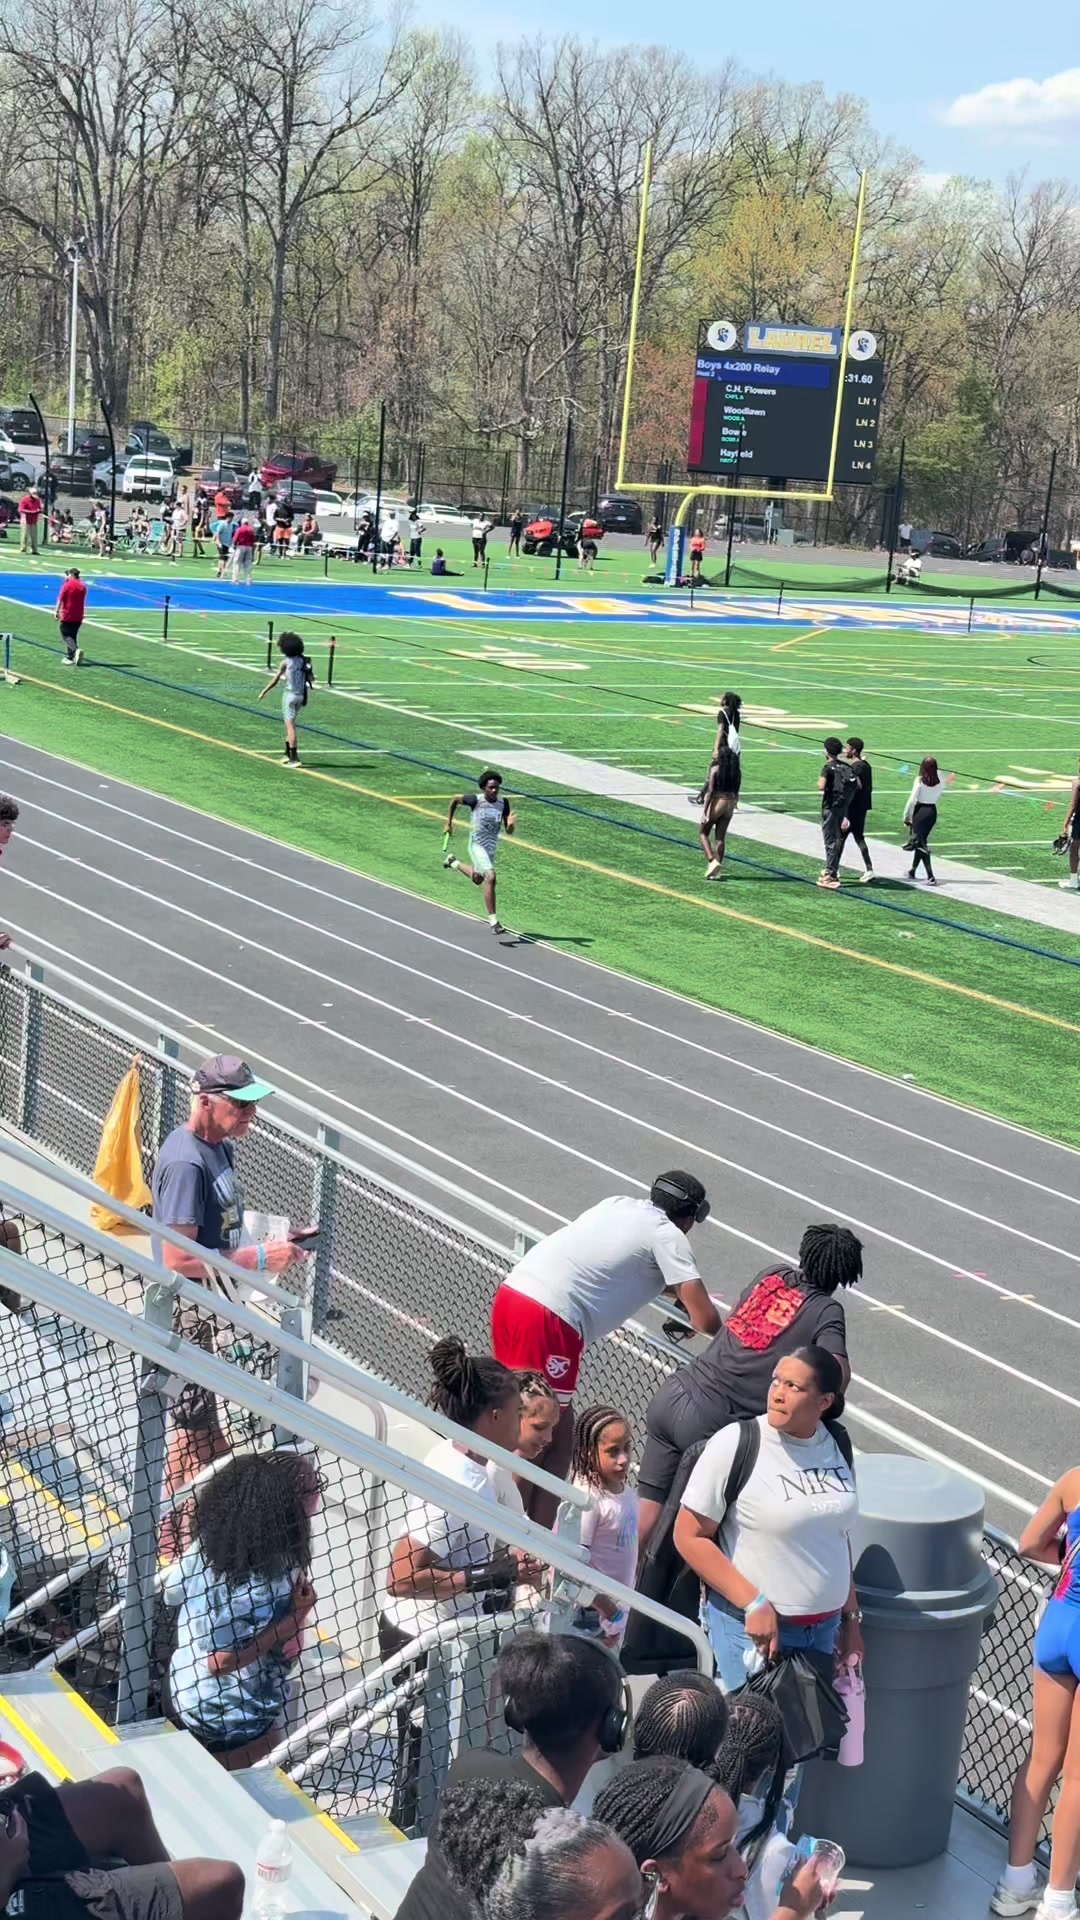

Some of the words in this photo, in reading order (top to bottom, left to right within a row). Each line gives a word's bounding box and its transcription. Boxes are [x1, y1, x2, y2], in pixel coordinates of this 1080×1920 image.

[697, 359, 721, 370] Boys
[723, 361, 752, 372] 4x200
[754, 364, 781, 375] Relay
[725, 384, 743, 393] C.H.
[744, 386, 777, 395] Flowers
[858, 397, 870, 405] LN
[872, 398, 877, 406] 1
[724, 406, 766, 416] Woodlawn
[856, 419, 868, 427] LN
[869, 419, 876, 427] 2
[722, 427, 747, 436] Bowe
[854, 440, 866, 448] LN
[720, 448, 753, 459] Hayfeld
[852, 461, 864, 469] LN
[865, 462, 871, 470] 4
[776, 1466, 856, 1502] NIKE
